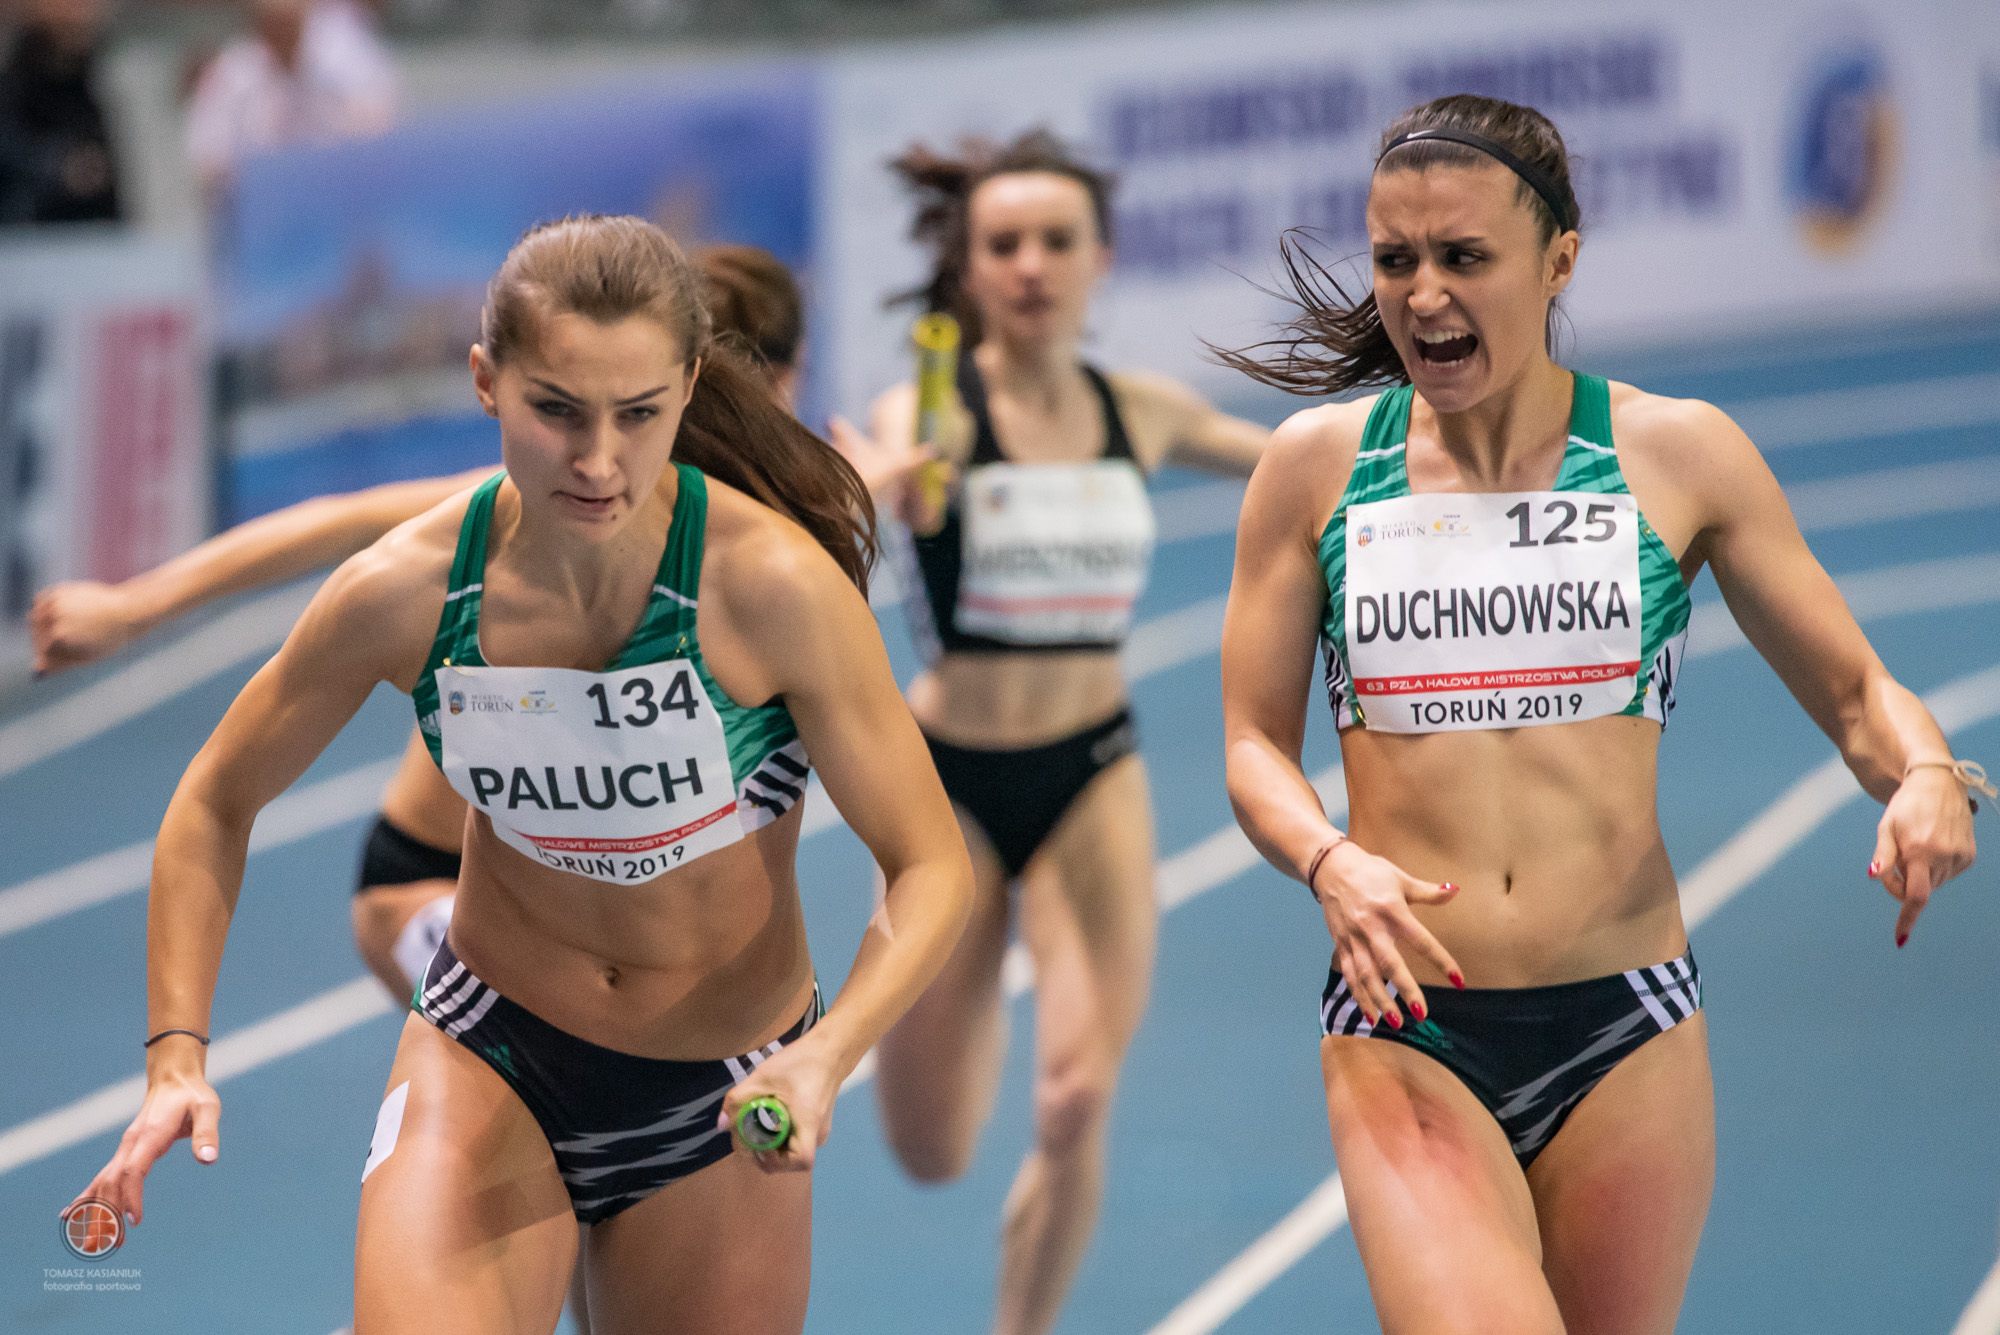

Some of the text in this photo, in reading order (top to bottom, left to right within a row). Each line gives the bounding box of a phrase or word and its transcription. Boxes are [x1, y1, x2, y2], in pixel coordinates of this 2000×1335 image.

[1505, 500, 1617, 548] 125
[1356, 580, 1631, 644] DUCHNOWSKA
[585, 669, 699, 729] 134
[1366, 667, 1626, 692] 63. PZLA HALOWE MISTRZOSTWA POLSKI
[1410, 691, 1583, 725] TORUŃ 2019
[469, 757, 703, 811] PALUCH
[588, 832, 680, 851] MISTRZOSTWA
[623, 845, 685, 880] 2019
